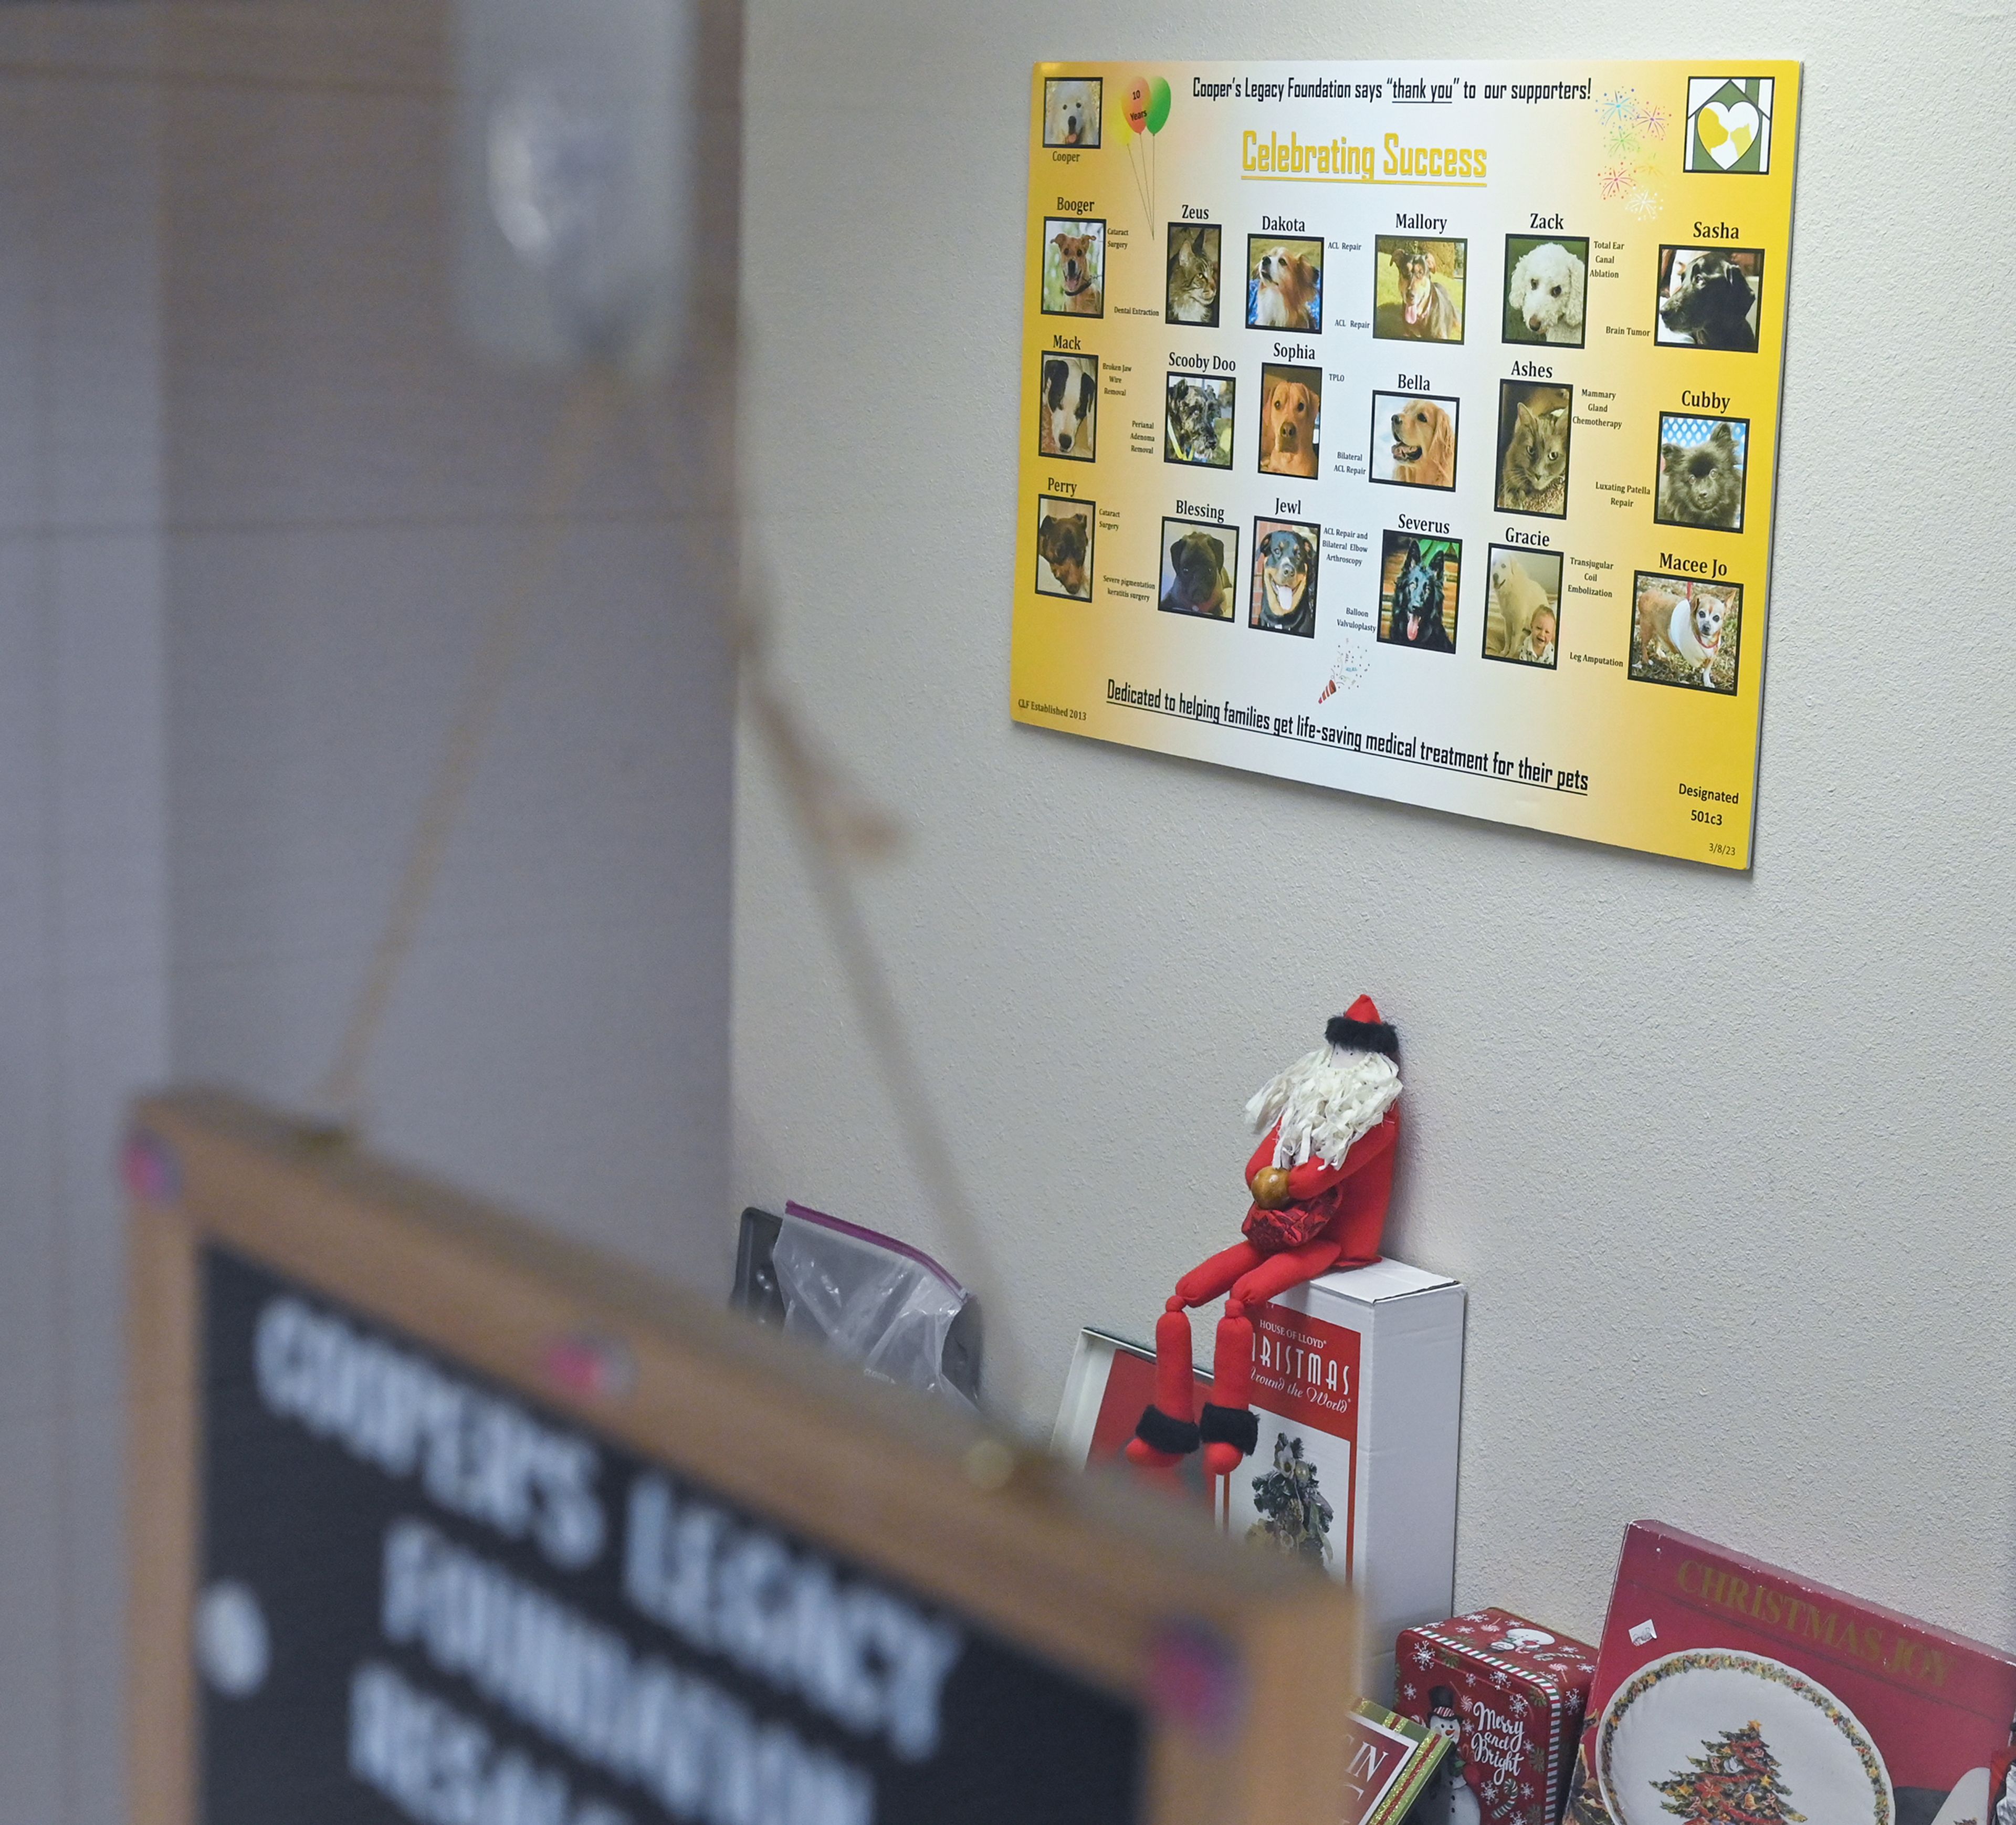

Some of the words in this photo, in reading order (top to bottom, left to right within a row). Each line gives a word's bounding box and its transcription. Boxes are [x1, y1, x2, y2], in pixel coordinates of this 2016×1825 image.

[1132, 90, 1140, 101] 10
[1193, 77, 1241, 101] Cooper's
[1245, 78, 1284, 102] Legacy
[1287, 78, 1350, 99] Foundation
[1355, 82, 1382, 103] says
[1464, 81, 1476, 99] to
[1485, 85, 1506, 99] our
[1511, 78, 1592, 104] supporters!
[1130, 109, 1148, 121] Years
[1052, 151, 1080, 164] Cooper
[1242, 130, 1375, 180] Celebrating
[1383, 132, 1487, 177] Success
[1056, 197, 1095, 214] Booger
[1181, 204, 1209, 220] Zeus
[1262, 216, 1306, 233] Dakota
[1395, 213, 1447, 234] Mallory
[1530, 213, 1564, 230] Zack
[1693, 222, 1740, 239] Sasha
[1107, 240, 1128, 250] Surgery
[1328, 242, 1339, 250] ACL
[1342, 243, 1362, 251] Repair
[1593, 240, 1611, 250] Total
[1612, 242, 1624, 250] Ear
[1595, 255, 1614, 264] Canal
[1590, 269, 1619, 279] Ablation
[1114, 306, 1131, 314] Dental
[1132, 308, 1159, 316] Extraction
[1335, 319, 1346, 328] ACL
[1350, 320, 1370, 330] Repair
[1605, 326, 1624, 335] Brain
[1626, 328, 1651, 337] Tumor
[1053, 335, 1081, 351] Mack
[1273, 342, 1316, 361] Sophia
[1122, 364, 1132, 373] Jaw
[1168, 352, 1210, 372] Scooby
[1212, 356, 1236, 372] Doo
[1511, 361, 1553, 379] Ashes
[1109, 375, 1122, 384] Wire
[1329, 374, 1345, 382] TPLO
[1397, 374, 1431, 391] Bella
[1581, 390, 1616, 401] Mammary
[1681, 391, 1731, 414] Cubby
[1588, 403, 1608, 413] Gland
[1132, 421, 1154, 429] Perianal
[1572, 416, 1622, 430] Chemotherapy
[1130, 433, 1155, 442] Adenoma
[1131, 445, 1153, 454] Removal
[1337, 452, 1363, 462] Bilateral
[1334, 465, 1345, 473] ACL
[1347, 466, 1366, 475] Repair
[1047, 477, 1077, 497] Perry
[1595, 482, 1625, 494] Luxating
[1627, 485, 1651, 495] Patella
[1275, 498, 1301, 515] Jewl
[1610, 498, 1634, 508] Repair
[1099, 509, 1120, 518] Cataract
[1175, 500, 1225, 523] Blessing
[1099, 521, 1119, 531] Surgery
[1398, 514, 1450, 534] Severus
[1324, 528, 1335, 537] ACL
[1336, 529, 1354, 539] Repair
[1356, 531, 1368, 540] and
[1505, 527, 1550, 547] Gracie
[1322, 540, 1348, 550] Bilateral
[1350, 543, 1368, 552] Elbow
[1326, 553, 1363, 567] Arthroscopy
[1570, 557, 1614, 570] Transjugular
[1659, 552, 1709, 574] Macee
[1712, 558, 1728, 579] Jo
[1103, 575, 1119, 584] Severe
[1120, 578, 1156, 590] pigmentation
[1584, 572, 1597, 582] Coil
[1107, 588, 1128, 597] keratitis
[1130, 592, 1150, 602] surgery
[1568, 584, 1612, 597] Embolization
[1346, 608, 1369, 617] Balloon
[1337, 618, 1377, 633] Valvuloplasty
[1569, 652, 1581, 663] Leg
[1582, 654, 1623, 667] Amputation
[1018, 699, 1030, 709] CLF
[1031, 701, 1068, 717] Established
[1069, 709, 1087, 721] 2013
[1107, 678, 1161, 708] Dedicated
[1164, 693, 1177, 711] to
[1179, 695, 1221, 723] helping
[1224, 702, 1270, 730] families
[1274, 716, 1294, 736] get
[1296, 715, 1362, 751] life-saving
[1366, 732, 1416, 758] medical
[1421, 741, 1489, 772] treatment
[1493, 751, 1514, 777] for
[1518, 757, 1553, 783] their
[1557, 770, 1589, 791] pets
[1678, 783, 1739, 804] Designated
[1690, 810, 1723, 826] 501c3
[1709, 843, 1736, 856] 3/8/23
[1260, 1319, 1285, 1336] HOUSE
[1287, 1329, 1297, 1339] OF
[1287, 1383, 1303, 1398] the
[1677, 1560, 1883, 1662] CHRISTMAS
[1885, 1637, 1957, 1686] JOY
[1473, 1701, 1525, 1753] Merry
[1484, 1732, 1509, 1750] and
[1471, 1733, 1525, 1785] Bright
